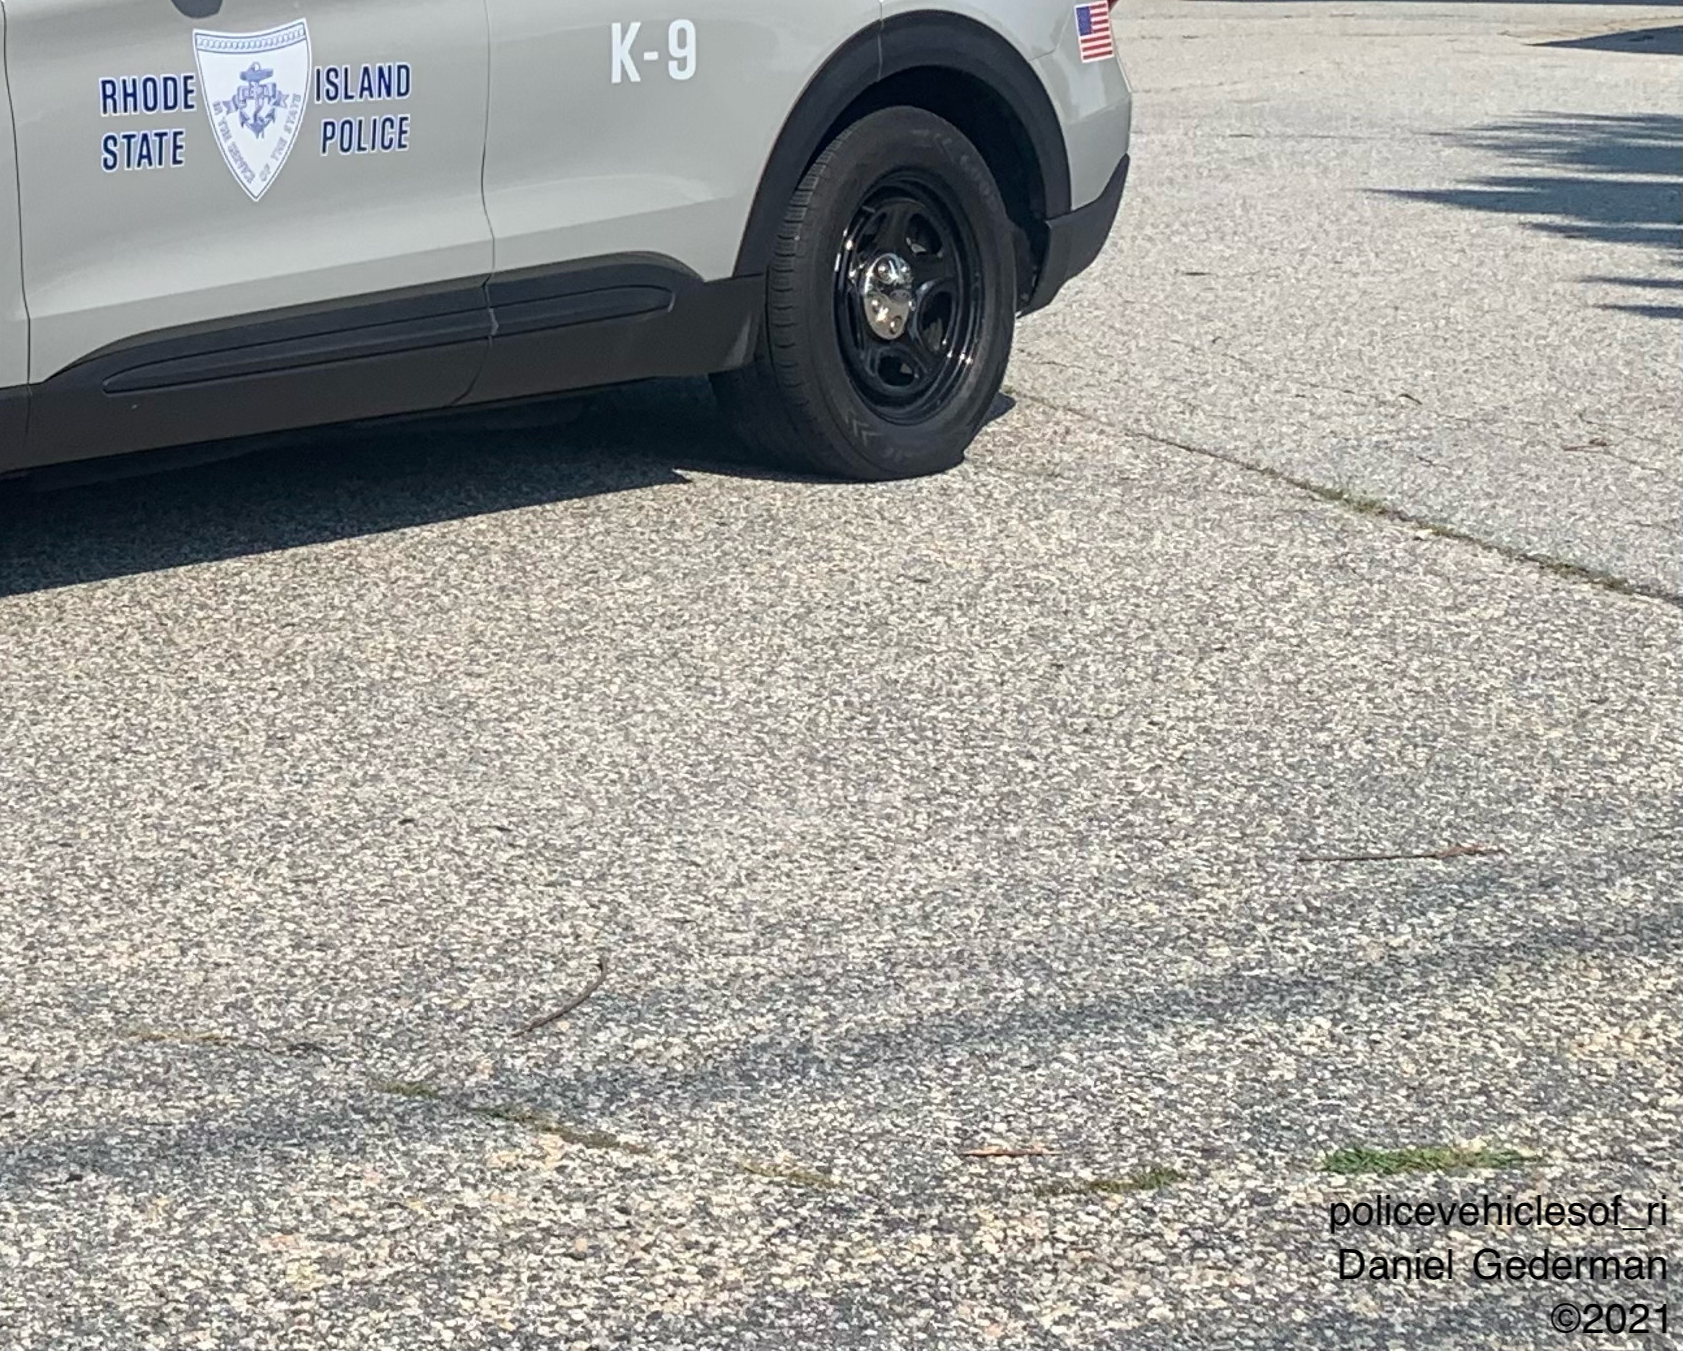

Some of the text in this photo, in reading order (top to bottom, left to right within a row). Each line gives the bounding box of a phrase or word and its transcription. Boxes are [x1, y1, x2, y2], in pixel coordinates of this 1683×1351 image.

[611, 18, 697, 84] K-9
[100, 63, 411, 115] RHODE ISLAND
[101, 115, 410, 171] STATE POLICE
